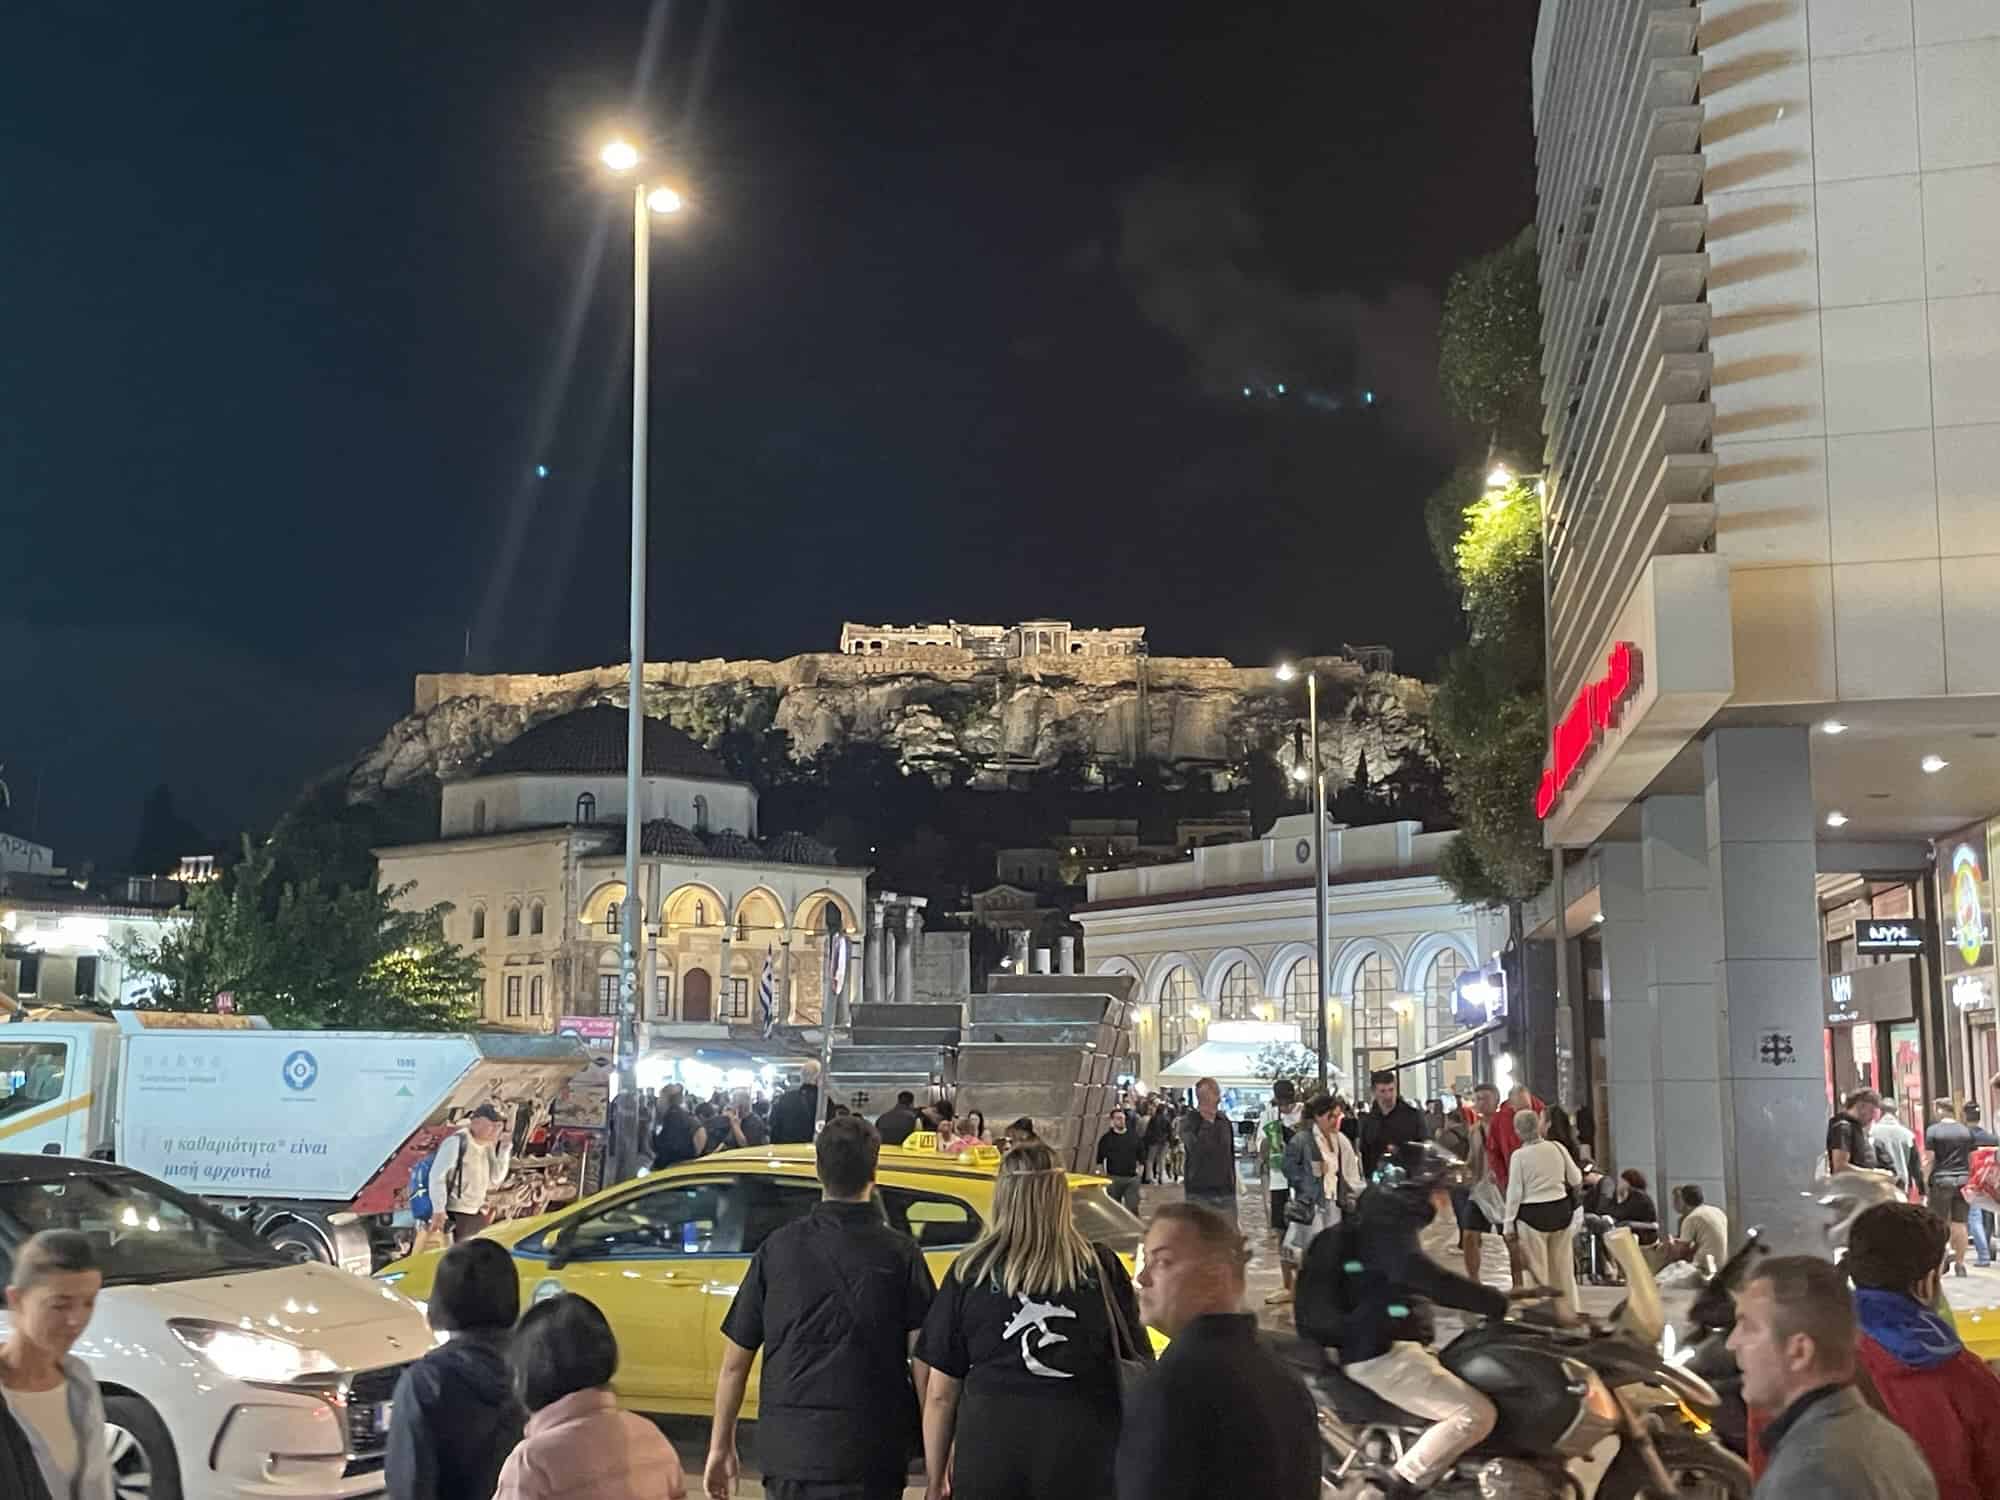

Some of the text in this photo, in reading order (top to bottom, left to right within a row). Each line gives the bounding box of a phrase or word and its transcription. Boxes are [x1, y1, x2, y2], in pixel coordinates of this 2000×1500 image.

[289, 1138, 328, 1155] είναι
[163, 1161, 272, 1181] μισή αρχοντιά
